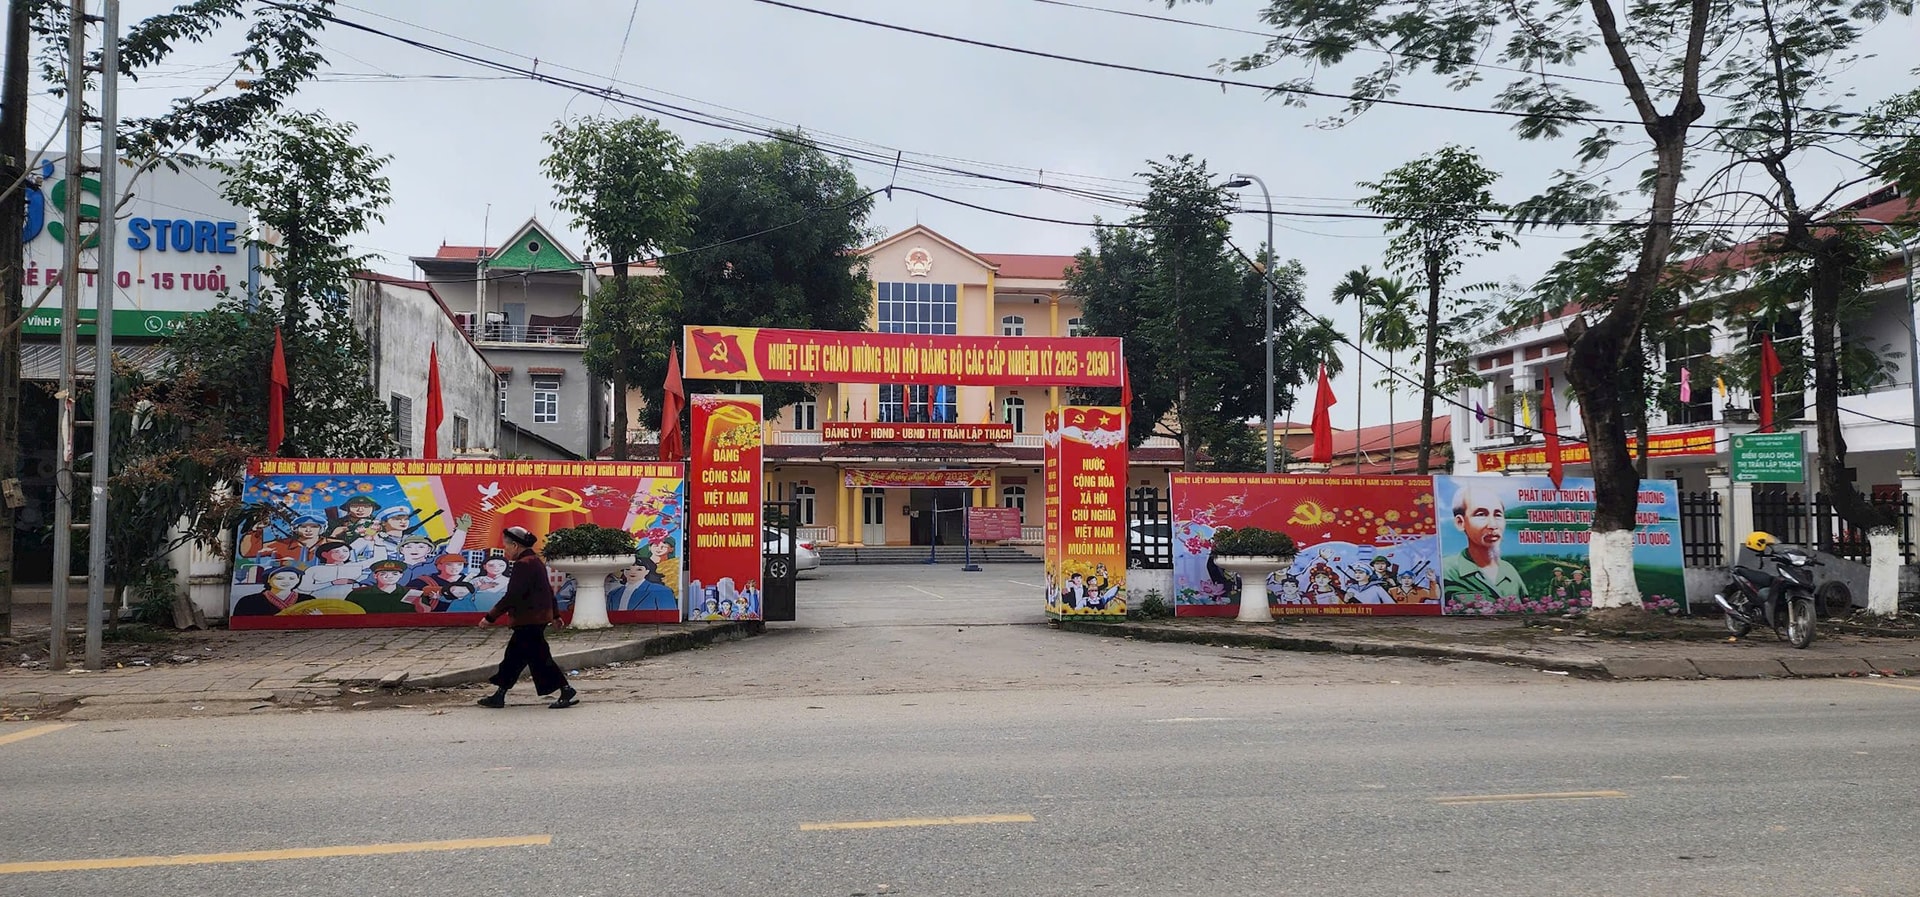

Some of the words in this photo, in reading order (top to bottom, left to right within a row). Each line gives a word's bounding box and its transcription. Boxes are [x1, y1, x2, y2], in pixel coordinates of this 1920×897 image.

[127, 217, 237, 255] STORE
[152, 272, 174, 290] 15
[181, 265, 226, 292] TUỔI
[28, 315, 51, 326] VĨNH
[768, 338, 798, 377] NHIỆT
[800, 339, 820, 378] LIỆT
[823, 340, 848, 372] CHÀO
[852, 340, 882, 374] MỪNG
[884, 347, 900, 380] ĐẠI
[902, 342, 919, 380] HỘI
[921, 340, 947, 375] ĐẢNG
[950, 344, 962, 380] BỘ
[965, 344, 984, 376] CÁC
[986, 340, 1006, 376] CẤP
[1008, 344, 1038, 382] NHIỆM
[1041, 346, 1052, 376] KỲ
[1055, 351, 1078, 376] 2025
[1086, 351, 1110, 376] 2030
[1111, 352, 1116, 376] !
[825, 424, 850, 439] ĐẢNG
[851, 423, 863, 439] ỦY
[870, 428, 894, 439] HĐND
[902, 428, 925, 440] UBND
[928, 428, 940, 442] THỊ
[942, 424, 964, 440] TRẤN
[966, 428, 984, 442] LẬP
[985, 429, 1012, 442] THẠCH
[713, 445, 740, 462] ĐẢNG
[1776, 452, 1794, 460] DỊCH
[516, 460, 533, 476] QUỐC
[534, 462, 548, 477] VIỆT
[1082, 456, 1106, 472] NƯỚC
[1748, 458, 1764, 468] TRẤN
[1766, 460, 1778, 470] LẬP
[702, 468, 728, 486] CỘNG
[730, 466, 750, 484] SẢN
[945, 472, 968, 480] 2025
[1074, 474, 1096, 490] CỘNG
[1098, 474, 1115, 488] HÒA
[1174, 476, 1190, 485] NHIỆT
[1192, 476, 1204, 485] LIỆT
[704, 490, 724, 507] VIỆT
[726, 492, 748, 505] NAM
[1080, 492, 1092, 505] XÃ
[1094, 492, 1108, 507] HỘI
[1518, 487, 1538, 502] PHÁT
[1542, 490, 1557, 502] HUY
[697, 512, 729, 528] QUANG
[732, 512, 754, 526] VINH
[1072, 506, 1089, 522] CHỦ
[1091, 507, 1117, 522] NGHĨA
[1528, 510, 1554, 522] THANH
[1556, 508, 1576, 522] NIÊN
[697, 532, 726, 548] MUÔN
[728, 533, 754, 548] NĂM!
[1074, 524, 1092, 541] VIỆT
[1094, 526, 1114, 538] NAM
[1560, 528, 1576, 544] LÊN
[1649, 528, 1670, 546] QUỐC
[1068, 542, 1094, 556] MUÔN
[1096, 542, 1115, 556] NĂM
[1117, 544, 1120, 556] !
